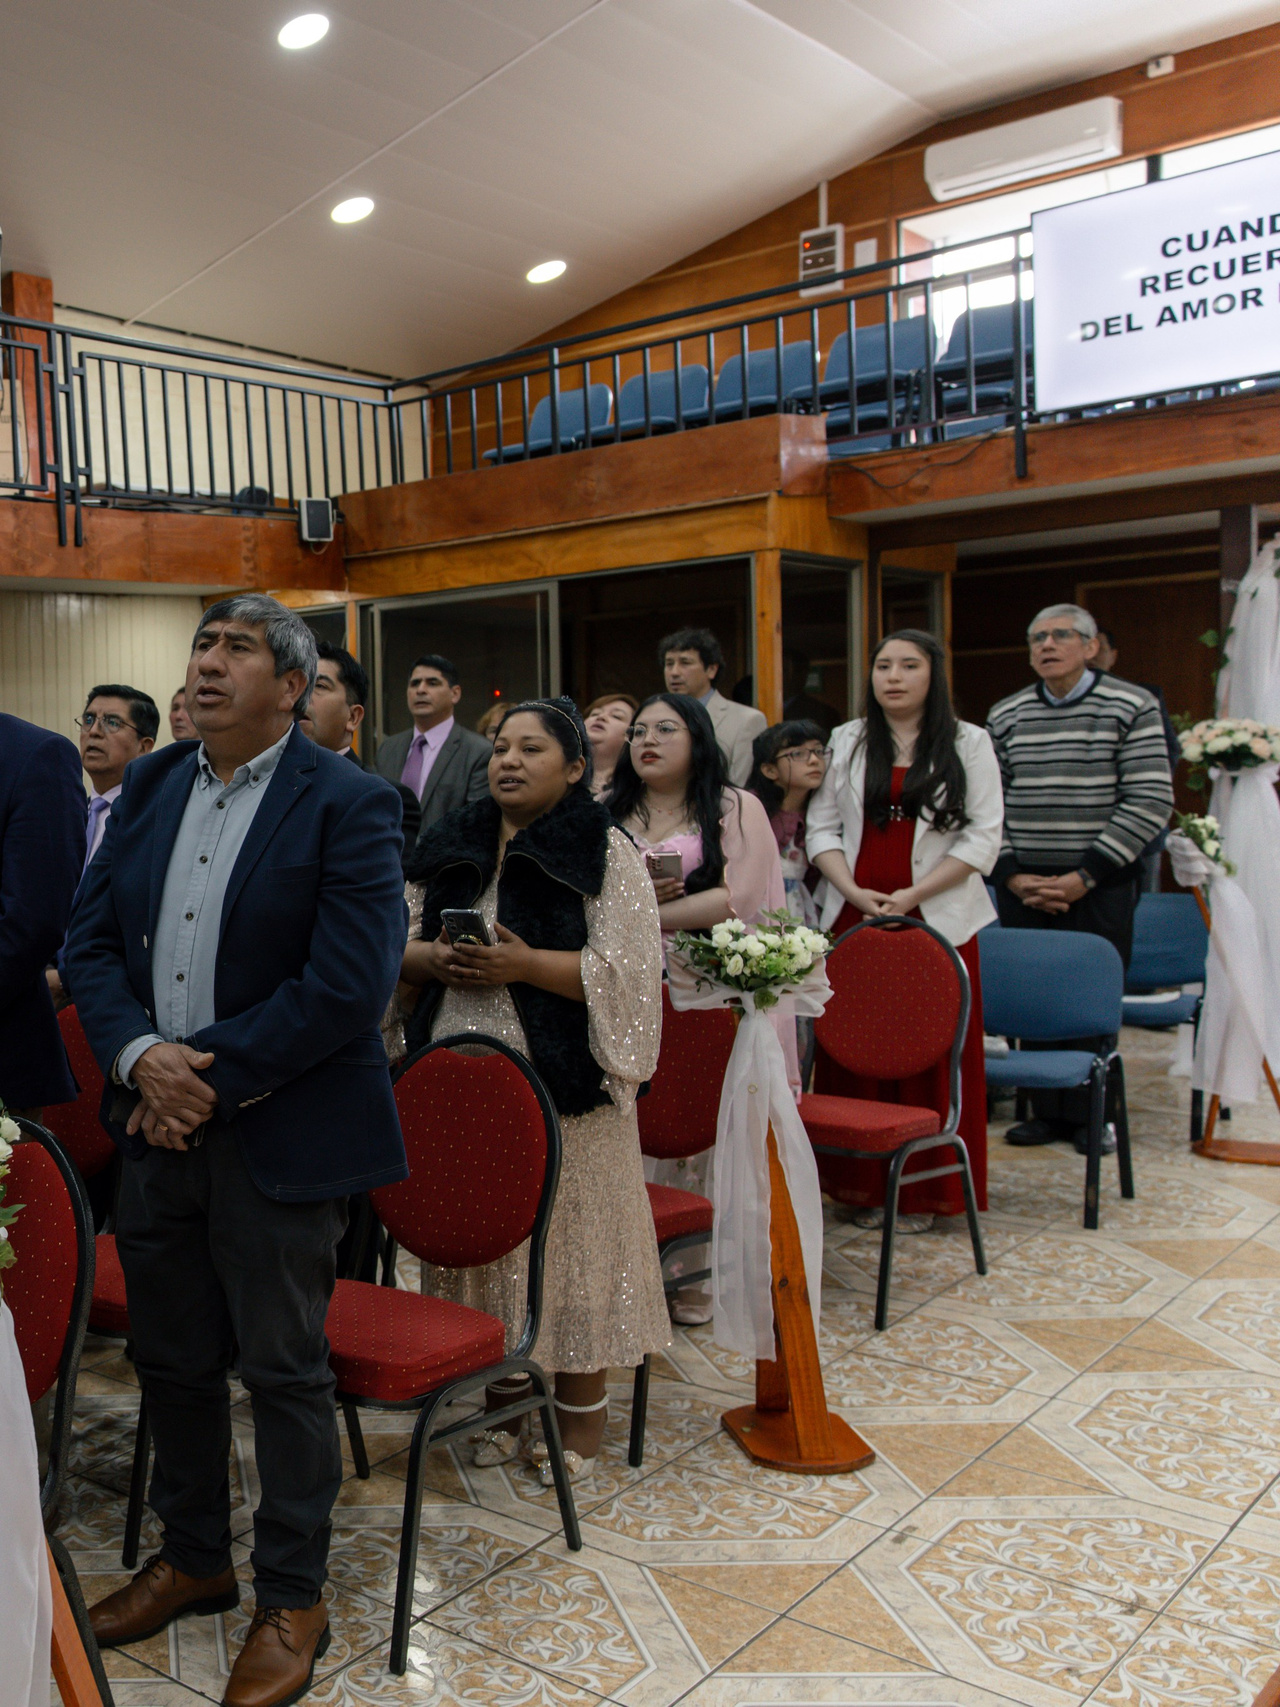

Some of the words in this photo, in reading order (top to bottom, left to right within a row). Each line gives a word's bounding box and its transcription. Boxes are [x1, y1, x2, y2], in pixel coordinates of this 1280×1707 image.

[1140, 248, 1280, 297] RECUER
[1080, 314, 1143, 342] DEL
[1156, 287, 1263, 327] AMOR
